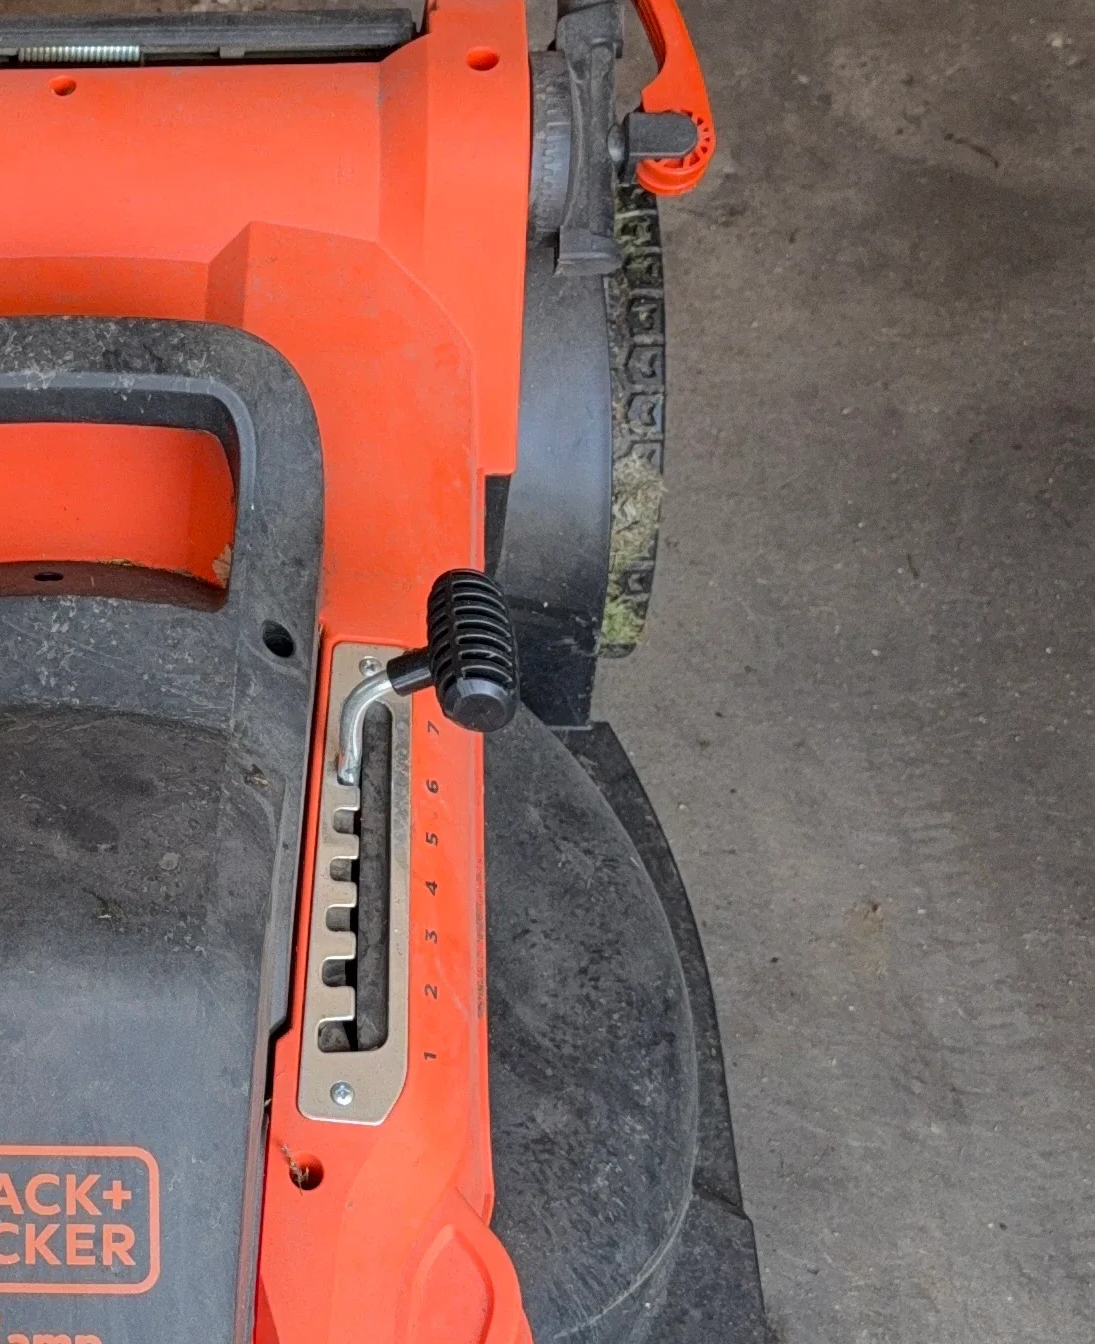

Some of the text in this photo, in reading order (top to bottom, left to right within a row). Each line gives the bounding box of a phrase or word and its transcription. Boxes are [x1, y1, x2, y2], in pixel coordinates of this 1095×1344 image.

[424, 720, 440, 1061] 1 2 3 4 5 6 7
